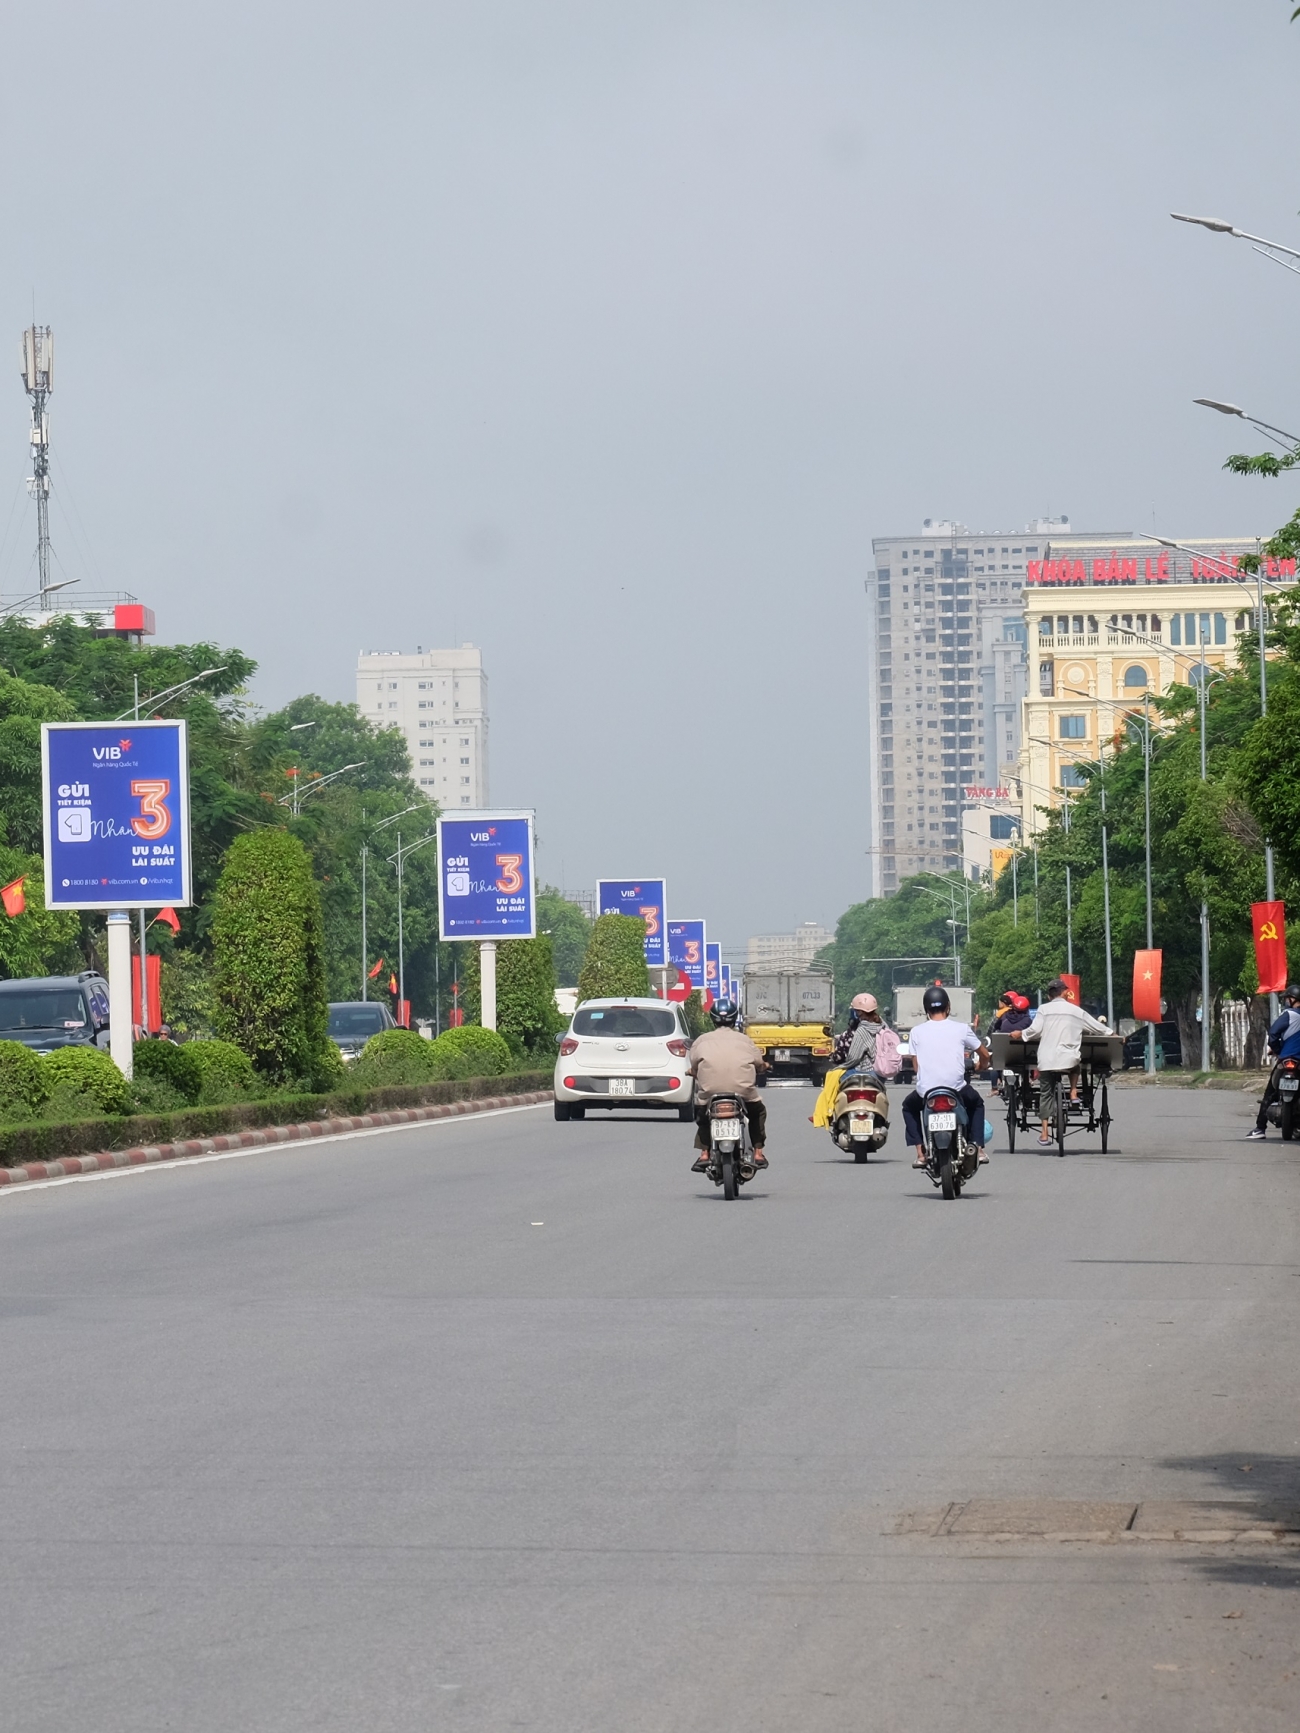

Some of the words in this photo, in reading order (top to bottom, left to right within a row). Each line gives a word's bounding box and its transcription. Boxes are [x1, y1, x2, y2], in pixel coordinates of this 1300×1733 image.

[93, 747, 121, 760] VIB
[58, 781, 89, 797] GỬI
[130, 779, 171, 840] 3
[470, 833, 490, 841] VIB
[447, 855, 469, 866] GỬI
[496, 854, 523, 894] 3
[615, 1079, 628, 1087] 38A
